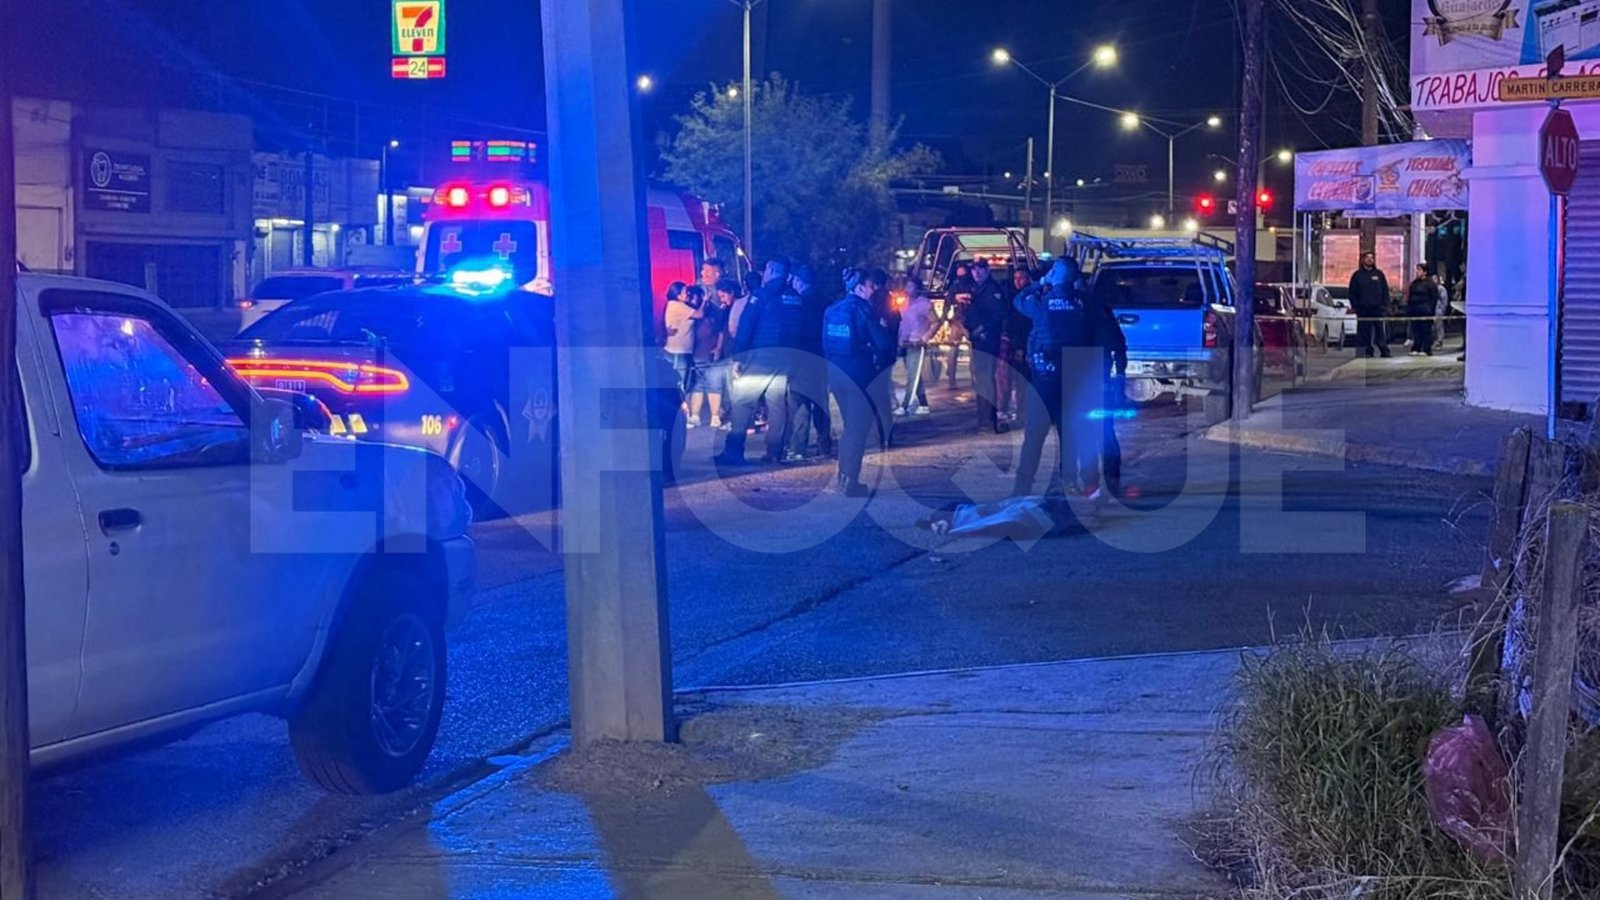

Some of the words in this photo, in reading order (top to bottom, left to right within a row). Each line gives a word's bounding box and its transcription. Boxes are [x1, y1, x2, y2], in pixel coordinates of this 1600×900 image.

[402, 5, 433, 52] 7
[410, 61, 426, 76] 24
[1416, 70, 1519, 106] TRABAJO
[1507, 83, 1546, 95] MARTIN
[1545, 135, 1577, 170] ALTO
[421, 415, 442, 435] 106
